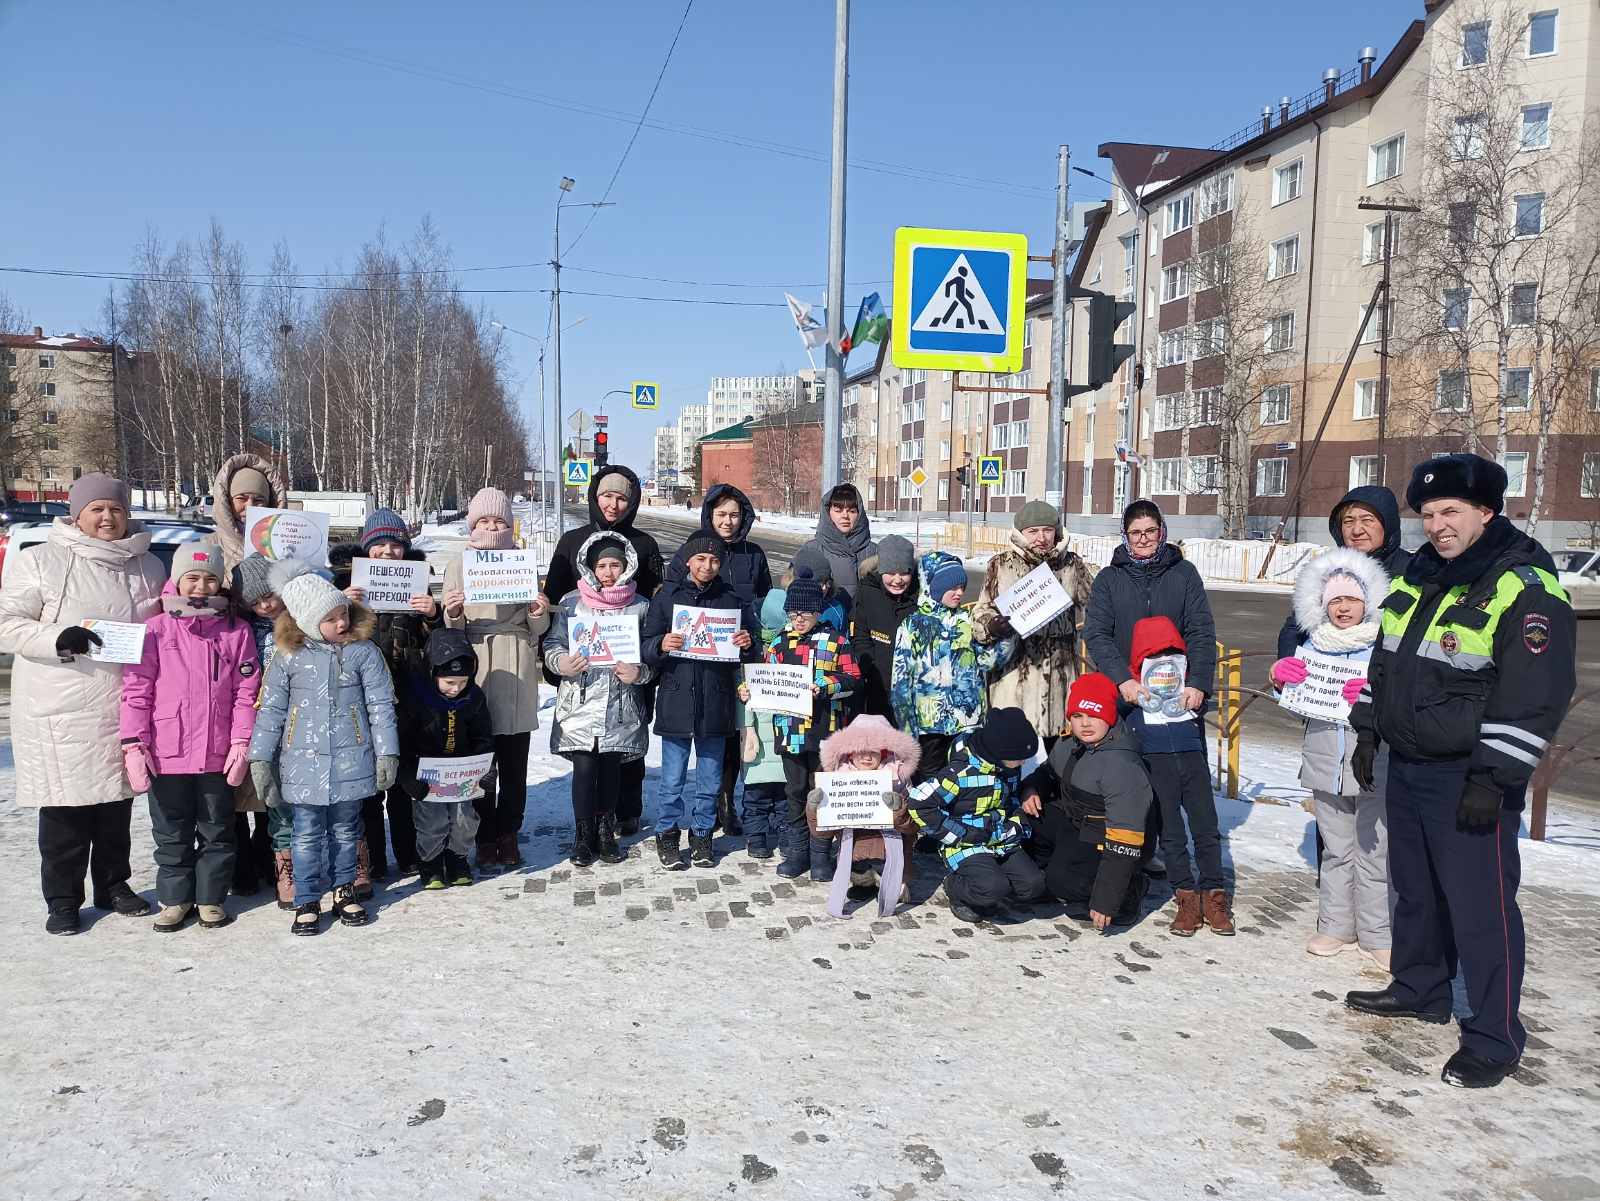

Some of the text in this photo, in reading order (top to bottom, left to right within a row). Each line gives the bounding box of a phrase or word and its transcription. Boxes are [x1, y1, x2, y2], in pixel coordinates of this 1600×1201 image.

[476, 551, 503, 563] Мы
[369, 566, 414, 578] ПЕШЕХОД!
[470, 579, 532, 589] дорожного
[368, 591, 411, 604] ПЕРЕХОД!
[470, 589, 532, 601] движения!
[1312, 660, 1329, 670] знает
[1331, 665, 1362, 676] правила
[1078, 700, 1103, 712] UFC
[1303, 695, 1340, 708] уважение!
[837, 812, 874, 821] осторожно!
